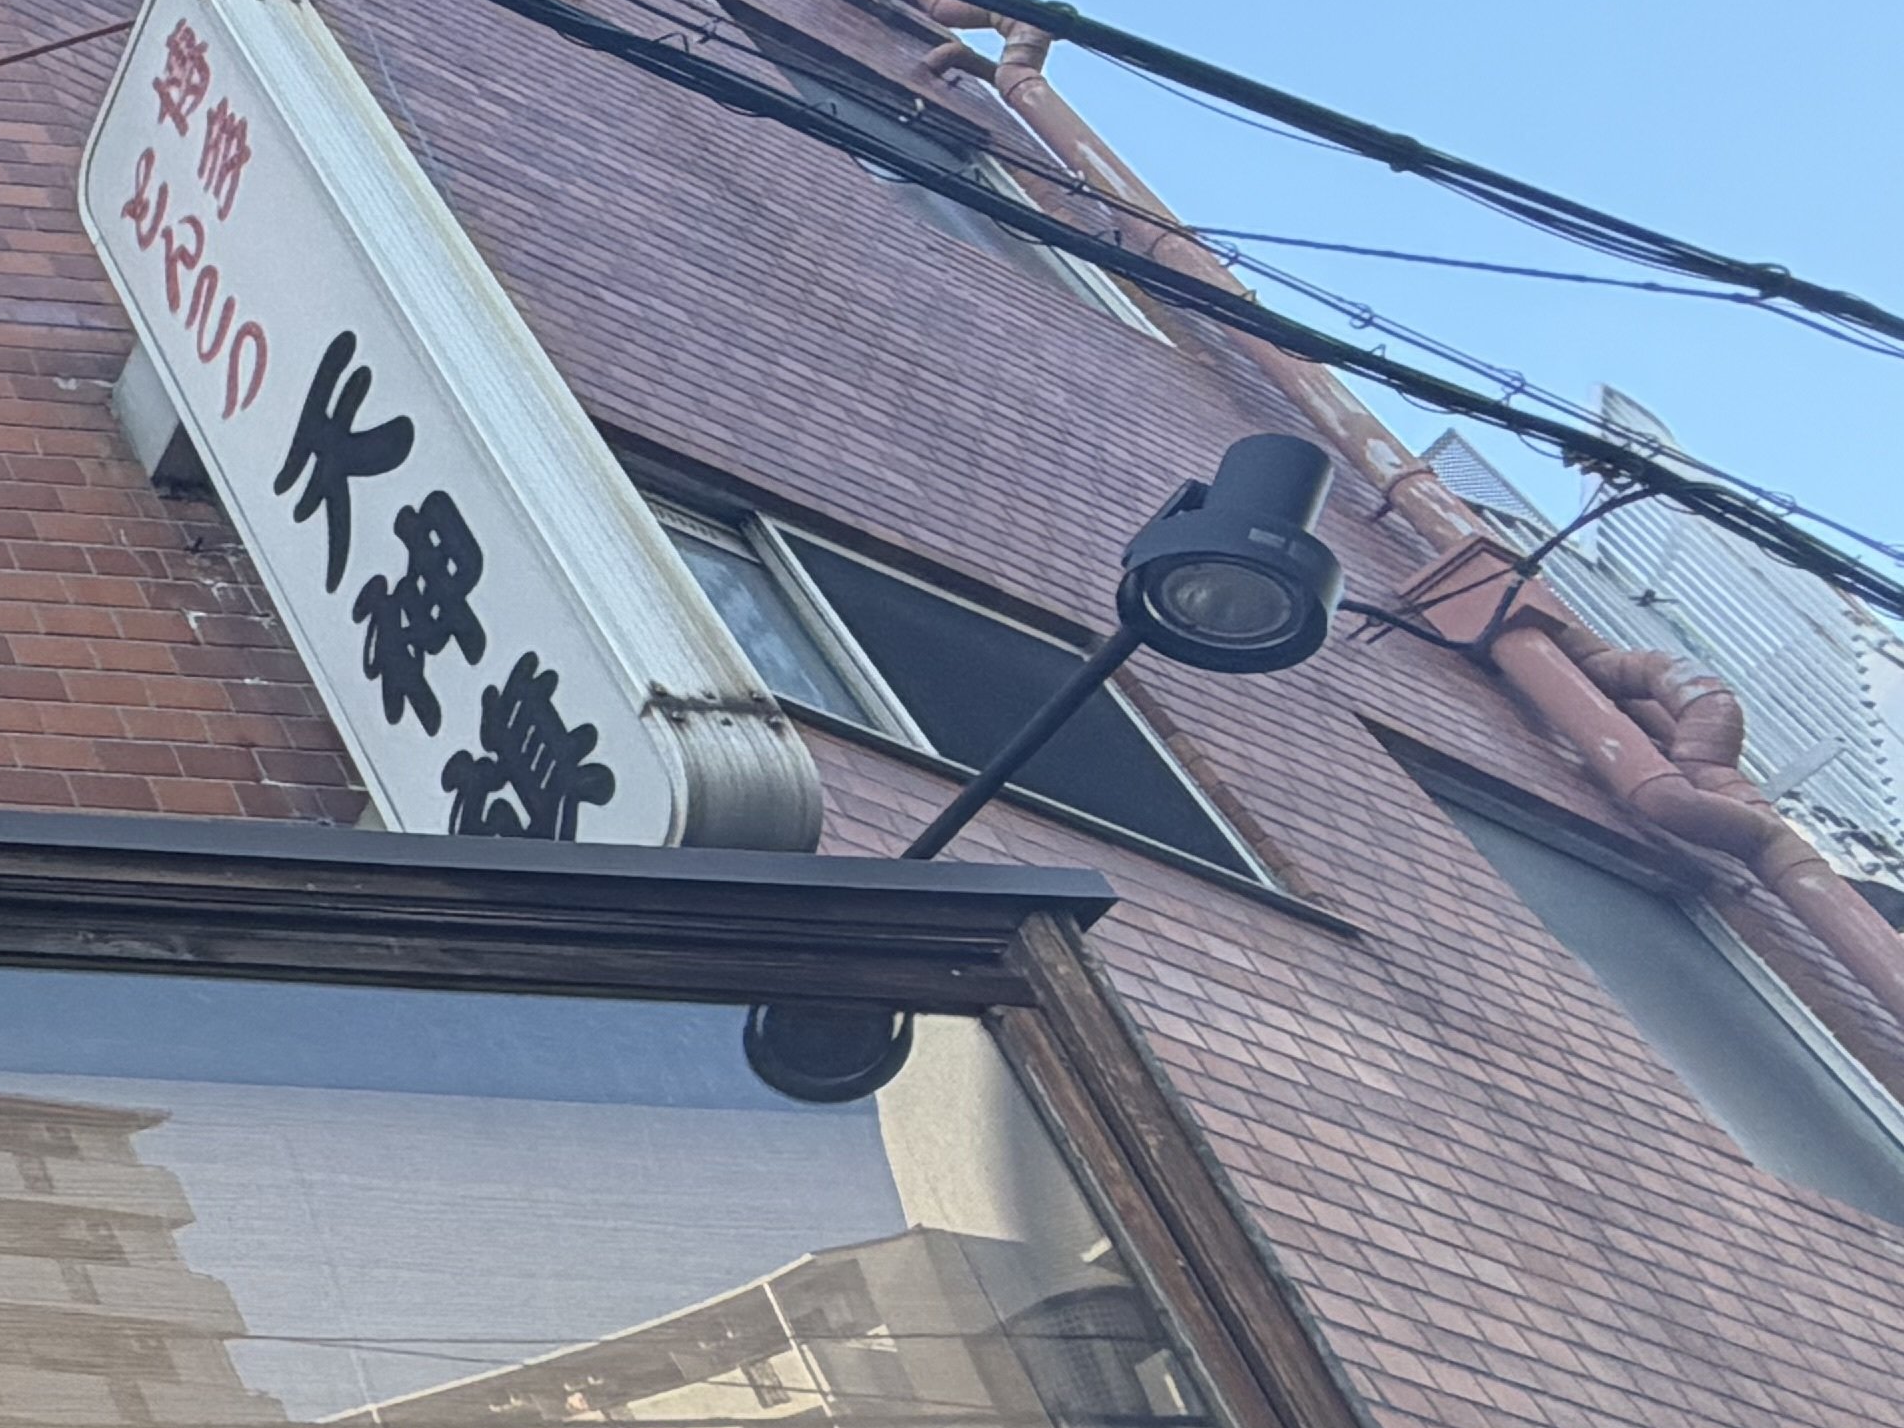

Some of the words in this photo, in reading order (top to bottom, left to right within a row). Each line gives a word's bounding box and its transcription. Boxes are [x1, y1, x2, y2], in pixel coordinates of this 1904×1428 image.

[151, 17, 253, 222] 博多
[120, 146, 268, 420] とんこつ
